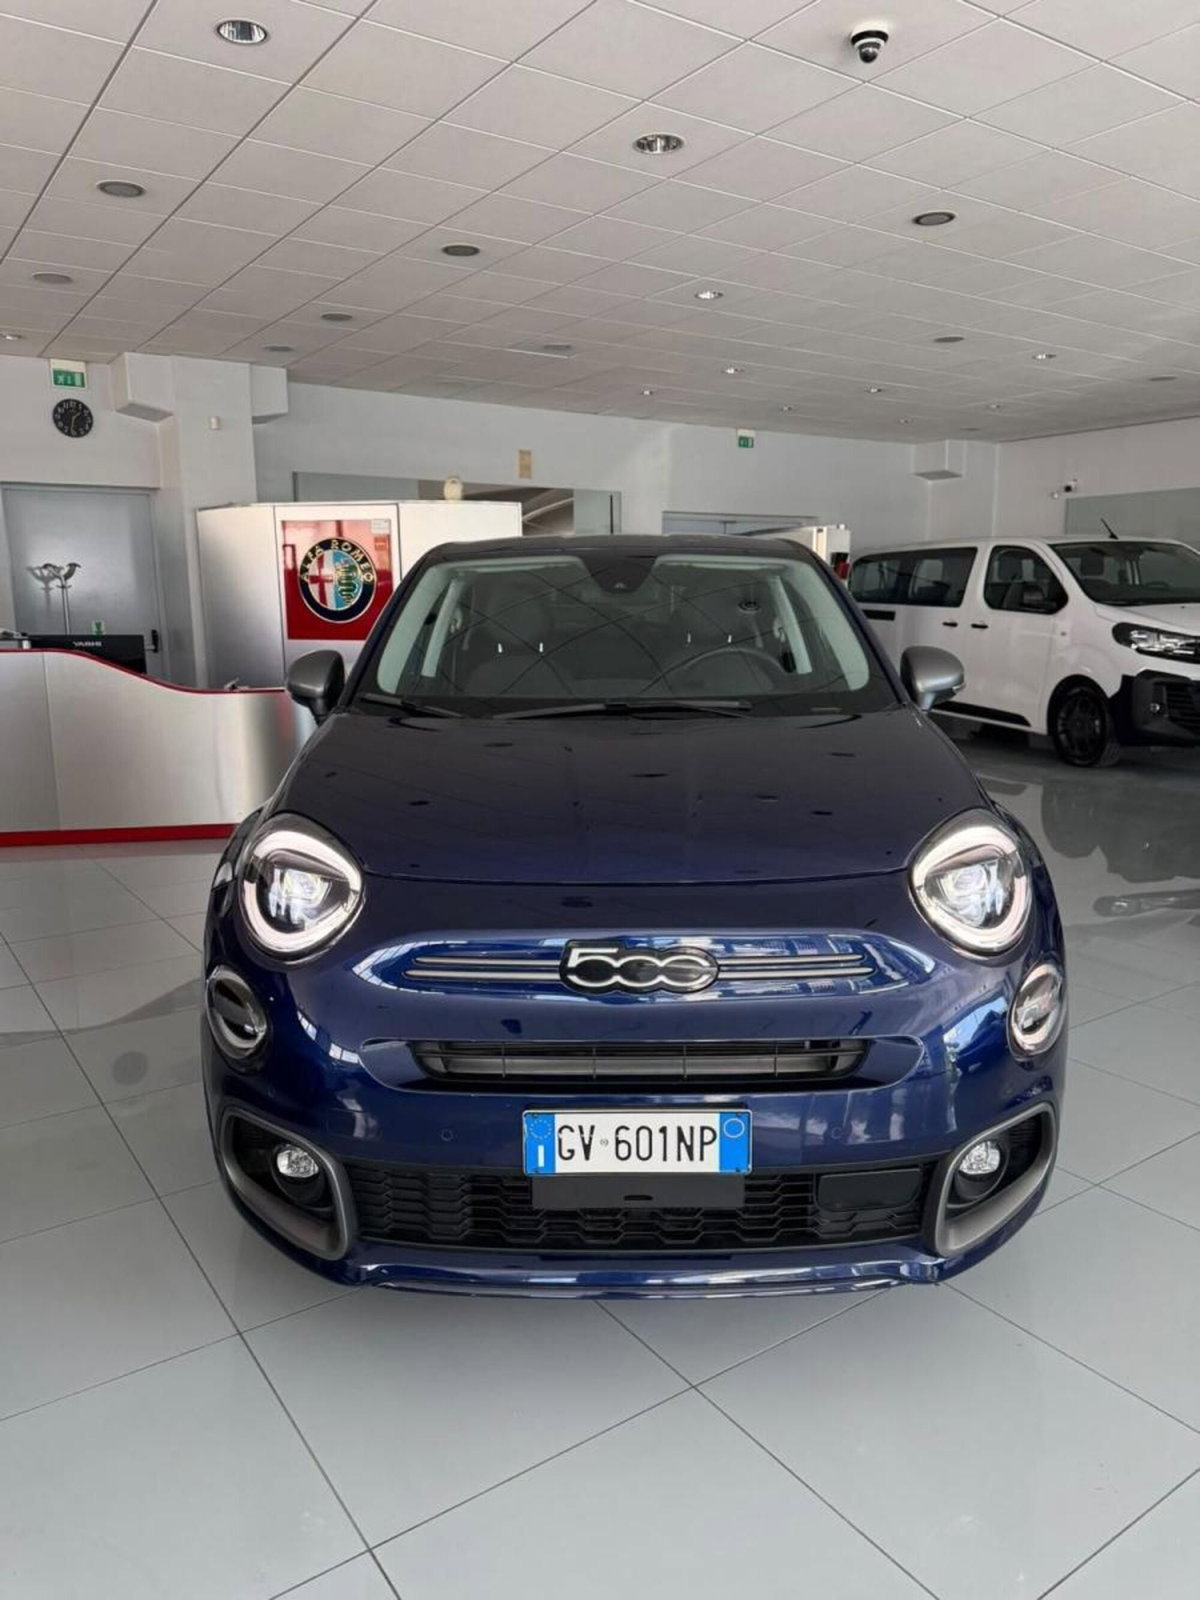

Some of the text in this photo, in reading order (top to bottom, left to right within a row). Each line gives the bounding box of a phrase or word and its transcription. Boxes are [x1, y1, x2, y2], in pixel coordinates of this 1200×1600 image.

[300, 539, 374, 582] ALFA ROMEO
[566, 947, 713, 988] 500
[557, 1124, 718, 1162] GV 601NP
